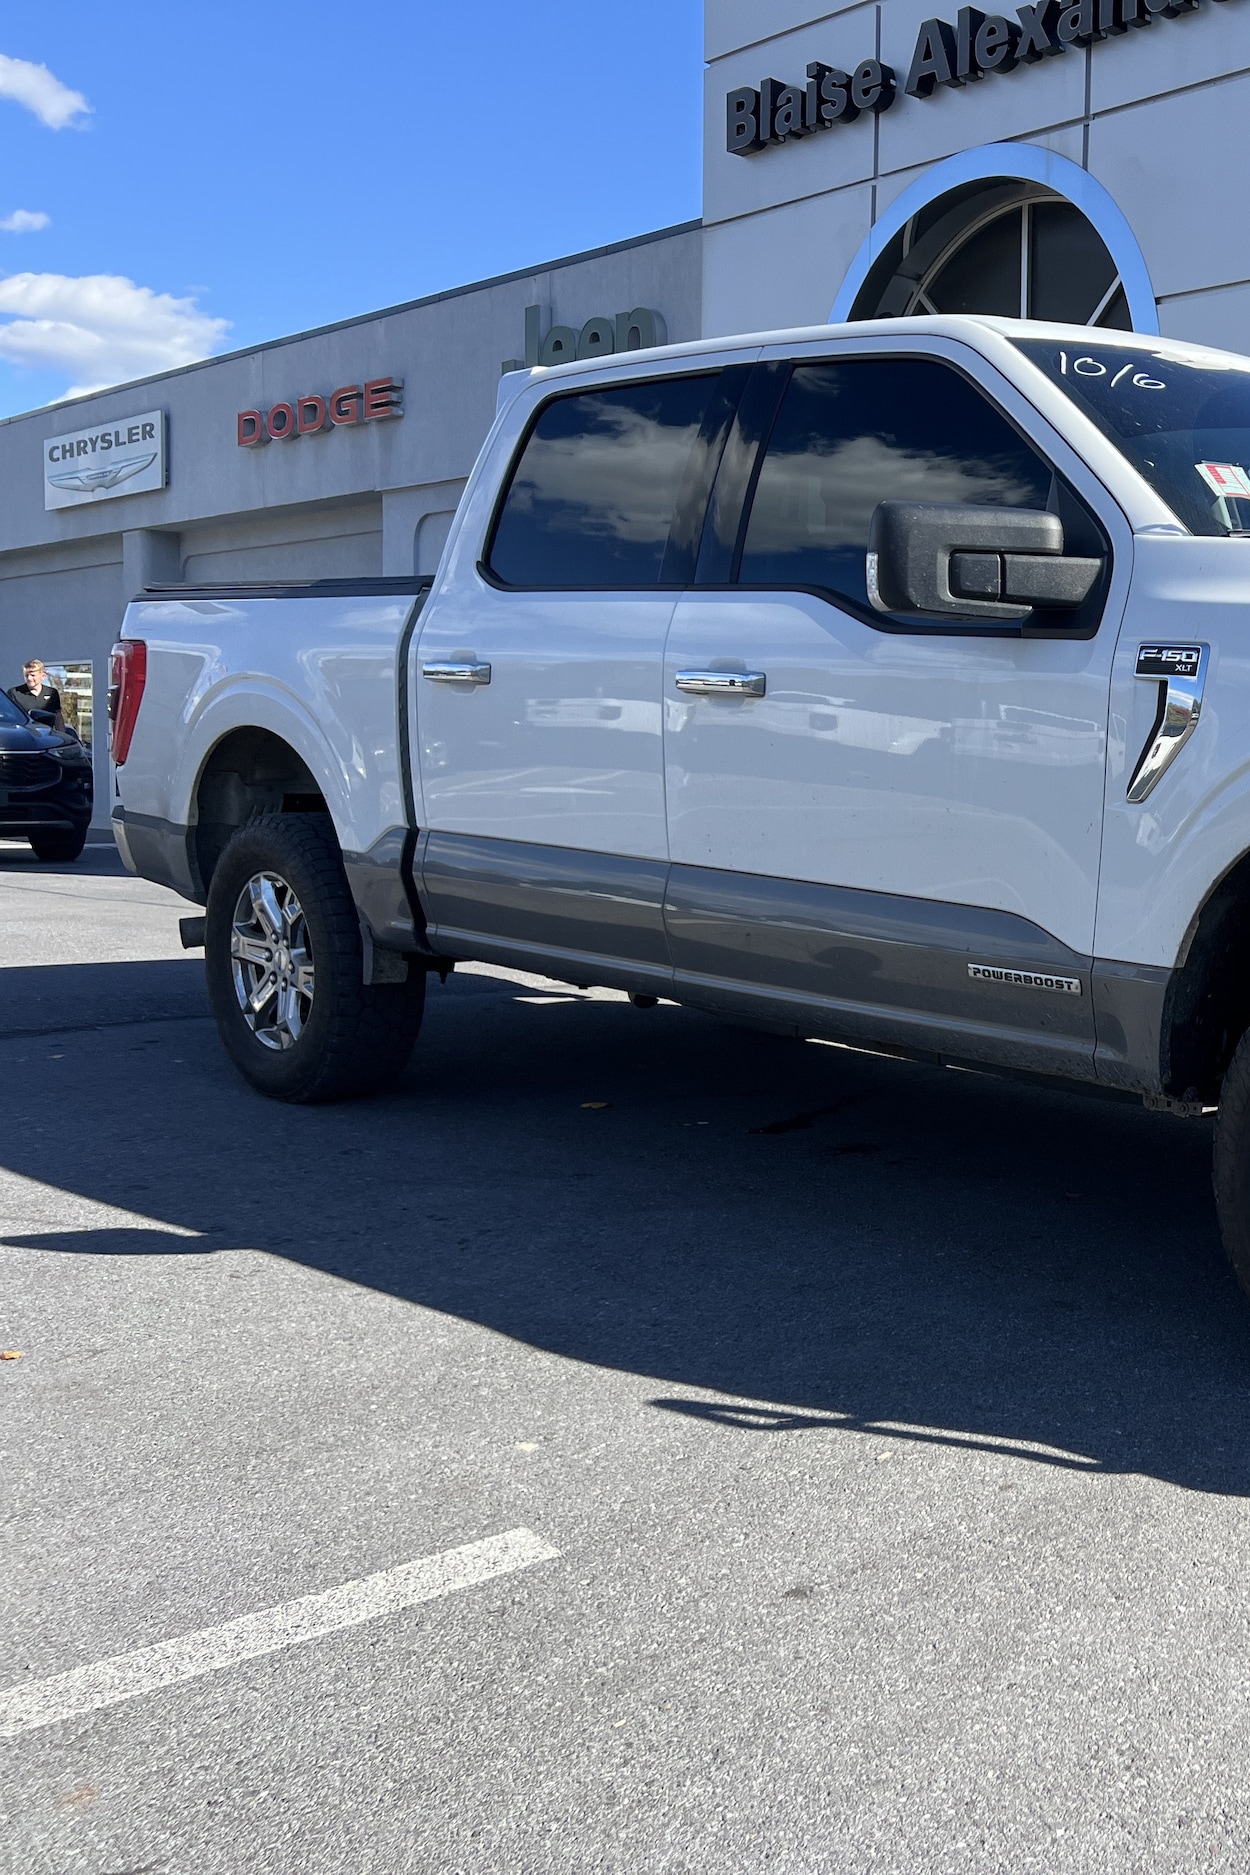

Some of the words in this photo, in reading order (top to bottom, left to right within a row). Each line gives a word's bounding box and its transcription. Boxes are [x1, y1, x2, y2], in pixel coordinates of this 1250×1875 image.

[726, 60, 896, 157] Blaise
[1059, 351, 1166, 389] 10/6
[237, 376, 404, 449] DODGE
[47, 422, 155, 464] CHRYSLER
[1139, 648, 1199, 663] F-150
[1174, 663, 1193, 672] XLT
[972, 966, 1074, 991] POWERBOOST
